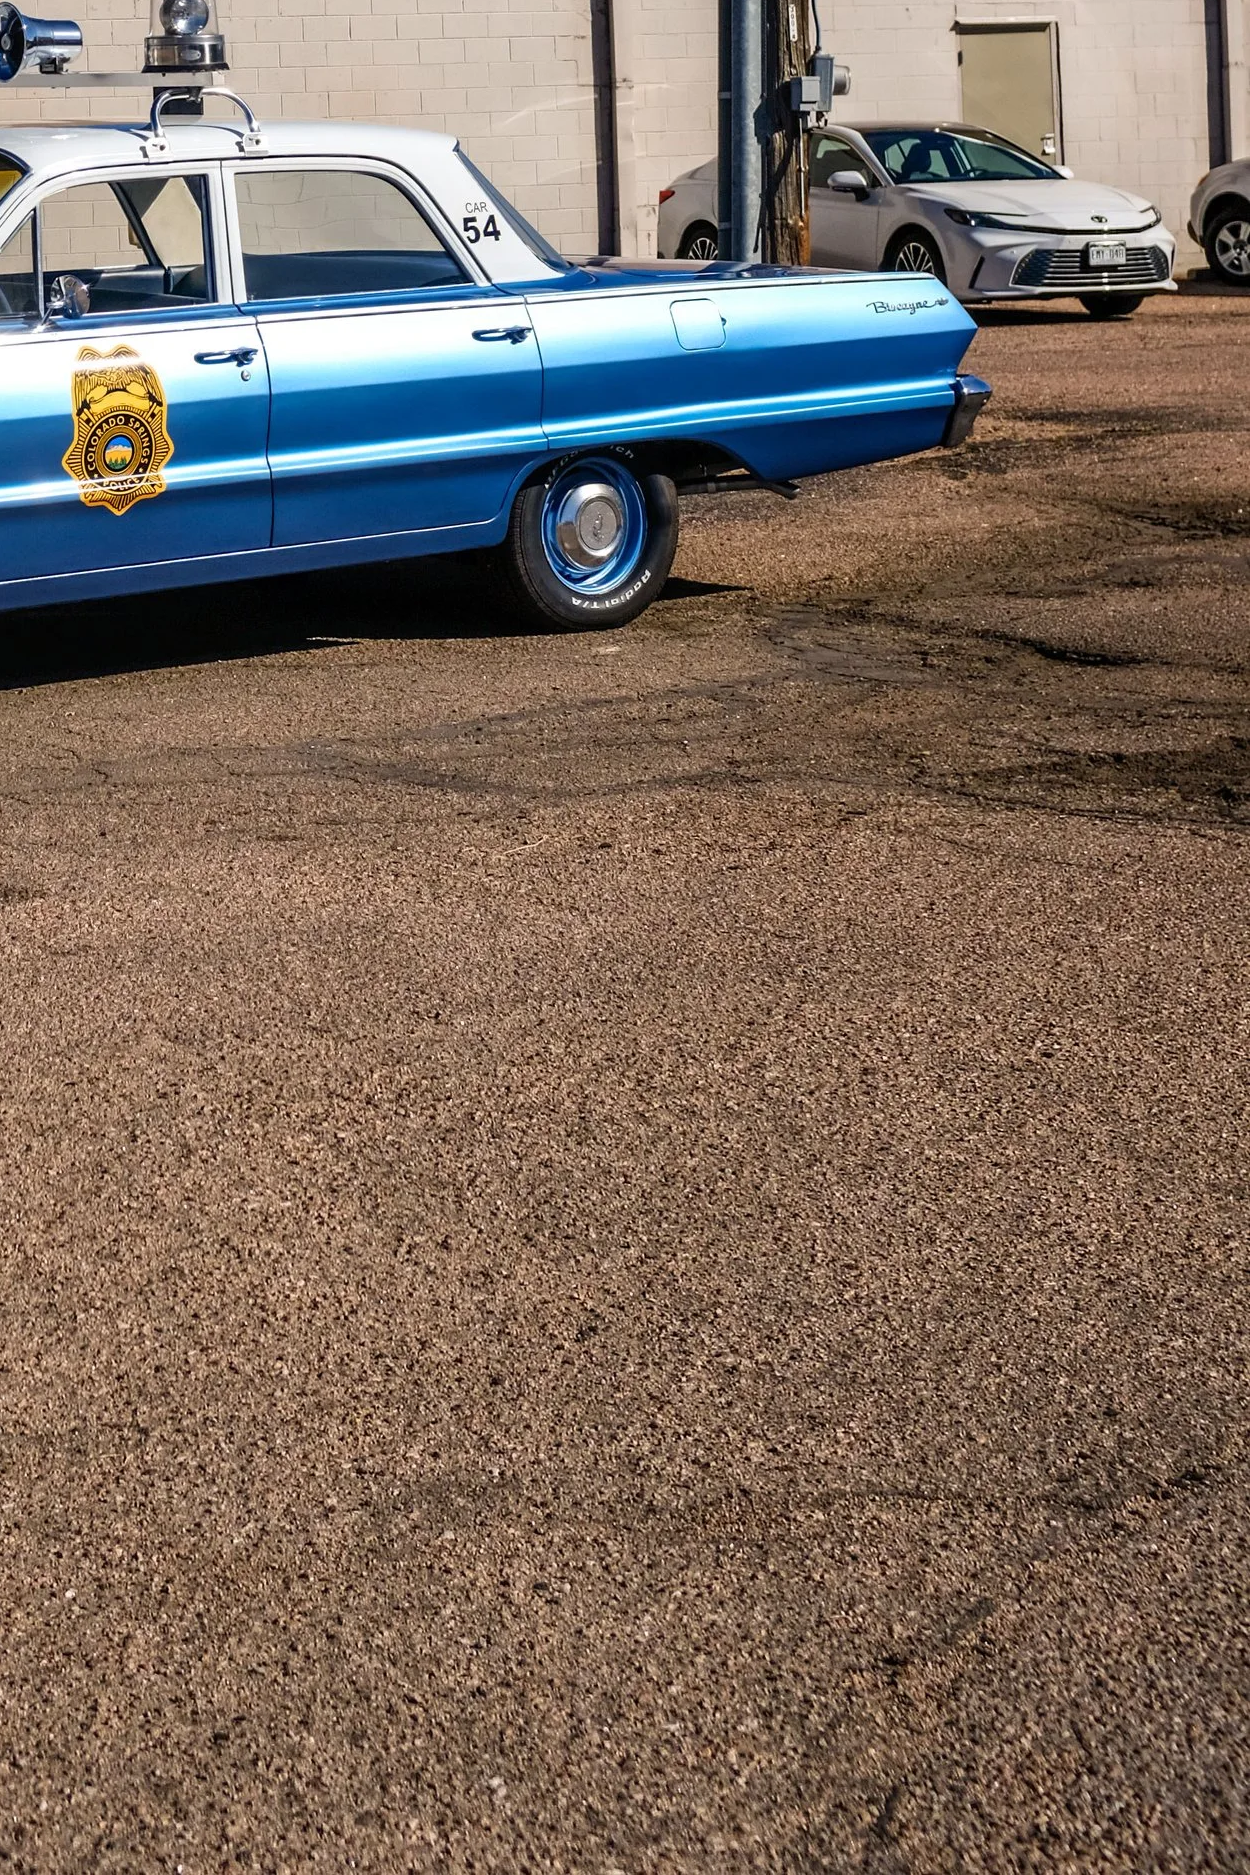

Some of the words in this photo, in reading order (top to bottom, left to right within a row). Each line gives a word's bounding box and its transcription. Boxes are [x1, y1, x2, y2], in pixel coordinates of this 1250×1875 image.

[465, 201, 488, 214] CAR
[463, 214, 501, 244] 54
[86, 415, 125, 471] COLORADO
[128, 417, 150, 465] SPRINGS
[102, 477, 141, 492] POLICE
[605, 569, 652, 607] Radial
[571, 596, 600, 609] T/A
